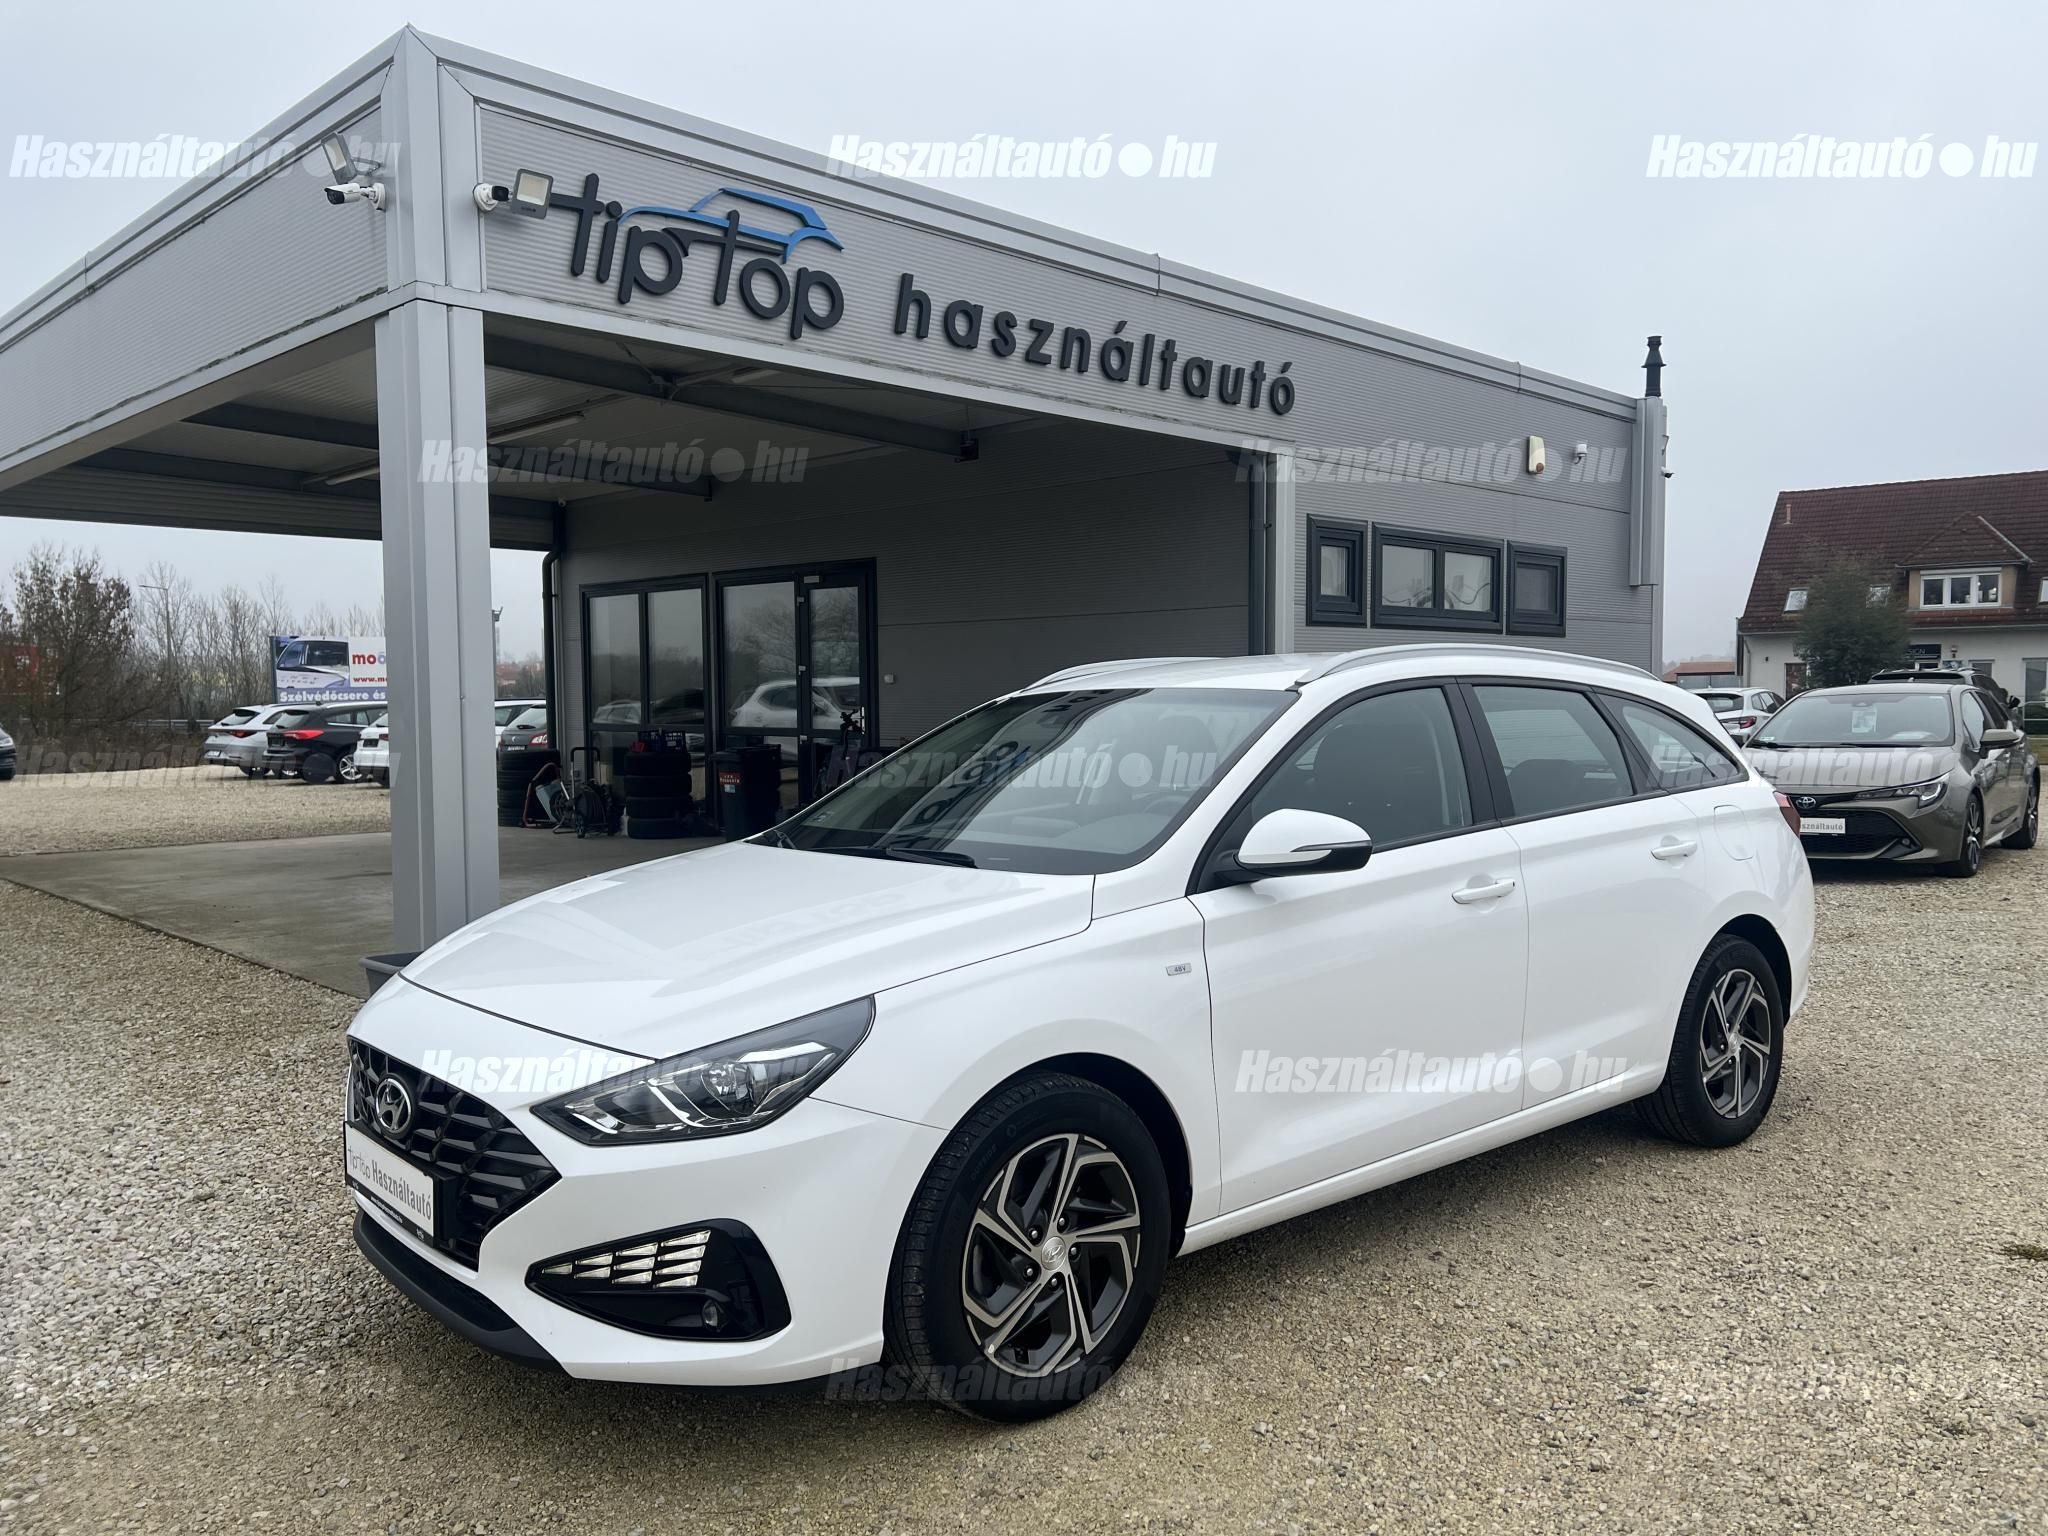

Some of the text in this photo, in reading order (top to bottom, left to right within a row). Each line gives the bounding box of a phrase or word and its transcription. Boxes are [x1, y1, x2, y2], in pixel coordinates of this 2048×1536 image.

[894, 272, 1296, 415] használtautó
[280, 690, 386, 702] Szélvédőcsere és
[1801, 822, 1844, 831] sználtautó
[371, 1159, 433, 1221] Használtautó
